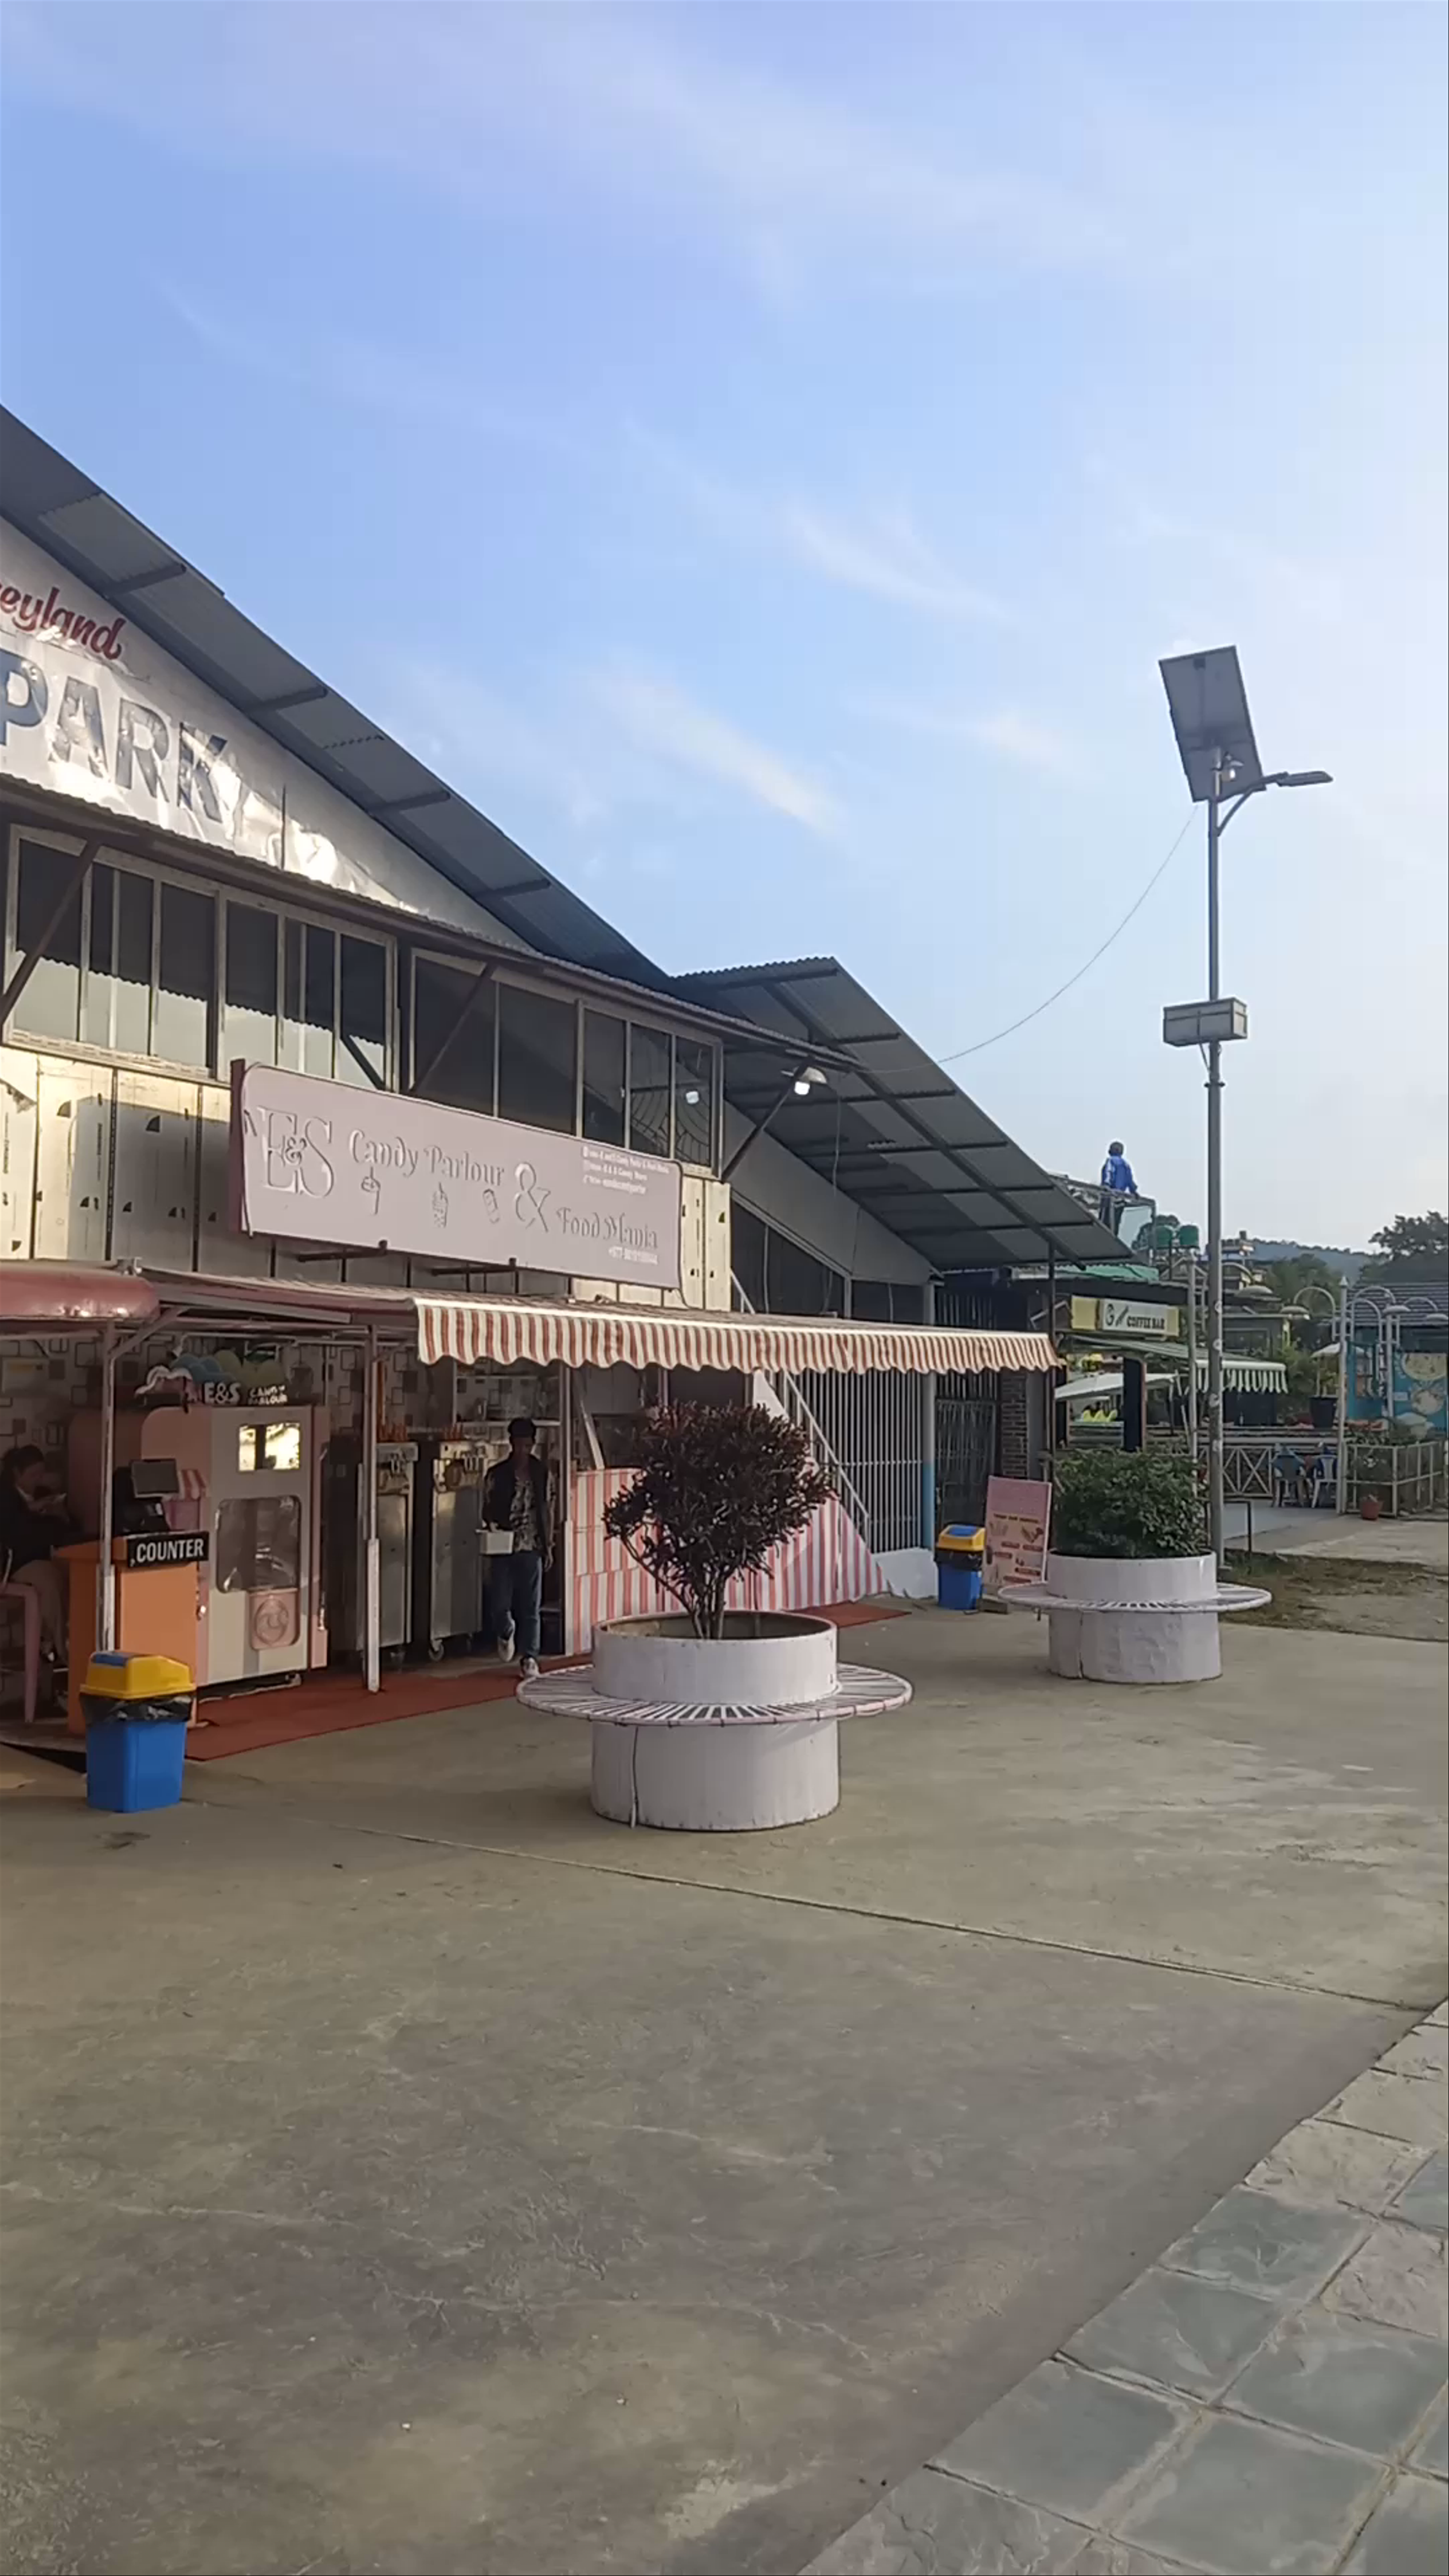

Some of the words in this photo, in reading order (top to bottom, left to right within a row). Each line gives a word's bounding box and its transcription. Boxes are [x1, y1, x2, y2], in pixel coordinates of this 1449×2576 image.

[0, 583, 126, 660] eyland
[0, 648, 227, 823] PARK
[349, 1129, 418, 1178] Candy
[423, 1146, 505, 1186] Parlour
[556, 1207, 600, 1238] Food
[603, 1212, 657, 1248] Mania
[204, 1382, 240, 1404] E&S
[136, 1538, 204, 1563] COUNTER
